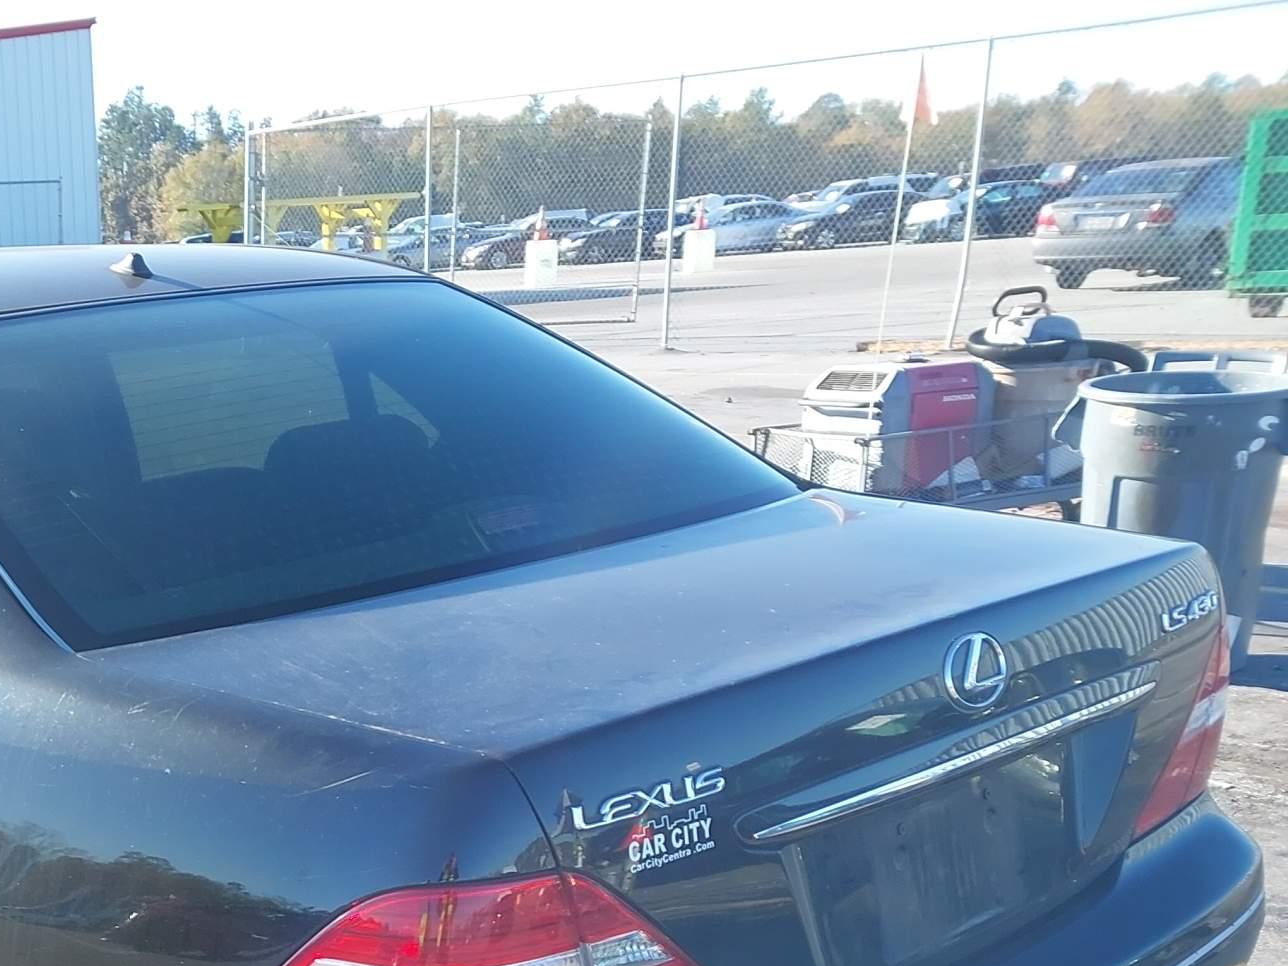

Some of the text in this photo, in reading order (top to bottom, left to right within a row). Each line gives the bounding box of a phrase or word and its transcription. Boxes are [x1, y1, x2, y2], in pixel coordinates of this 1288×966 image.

[570, 767, 726, 830] LEXUS
[628, 817, 712, 862] CAR CITY
